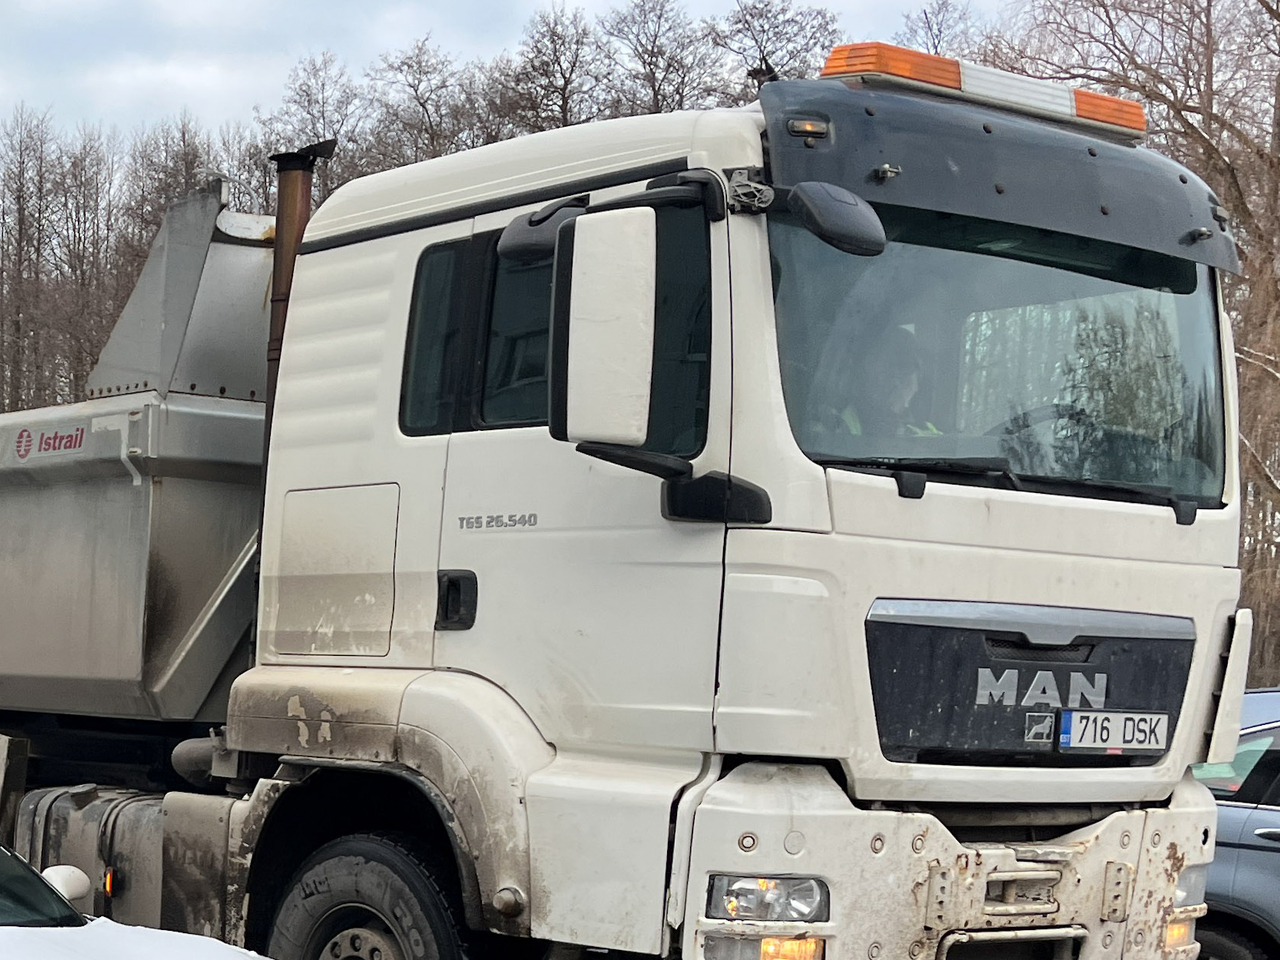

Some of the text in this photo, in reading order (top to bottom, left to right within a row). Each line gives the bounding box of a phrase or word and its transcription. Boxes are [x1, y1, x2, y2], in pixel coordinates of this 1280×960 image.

[38, 427, 85, 453] Istrail
[458, 513, 538, 529] TGS 26.540
[975, 667, 1108, 709] MAN
[1078, 715, 1111, 744] 716
[1122, 717, 1162, 745] DSK
